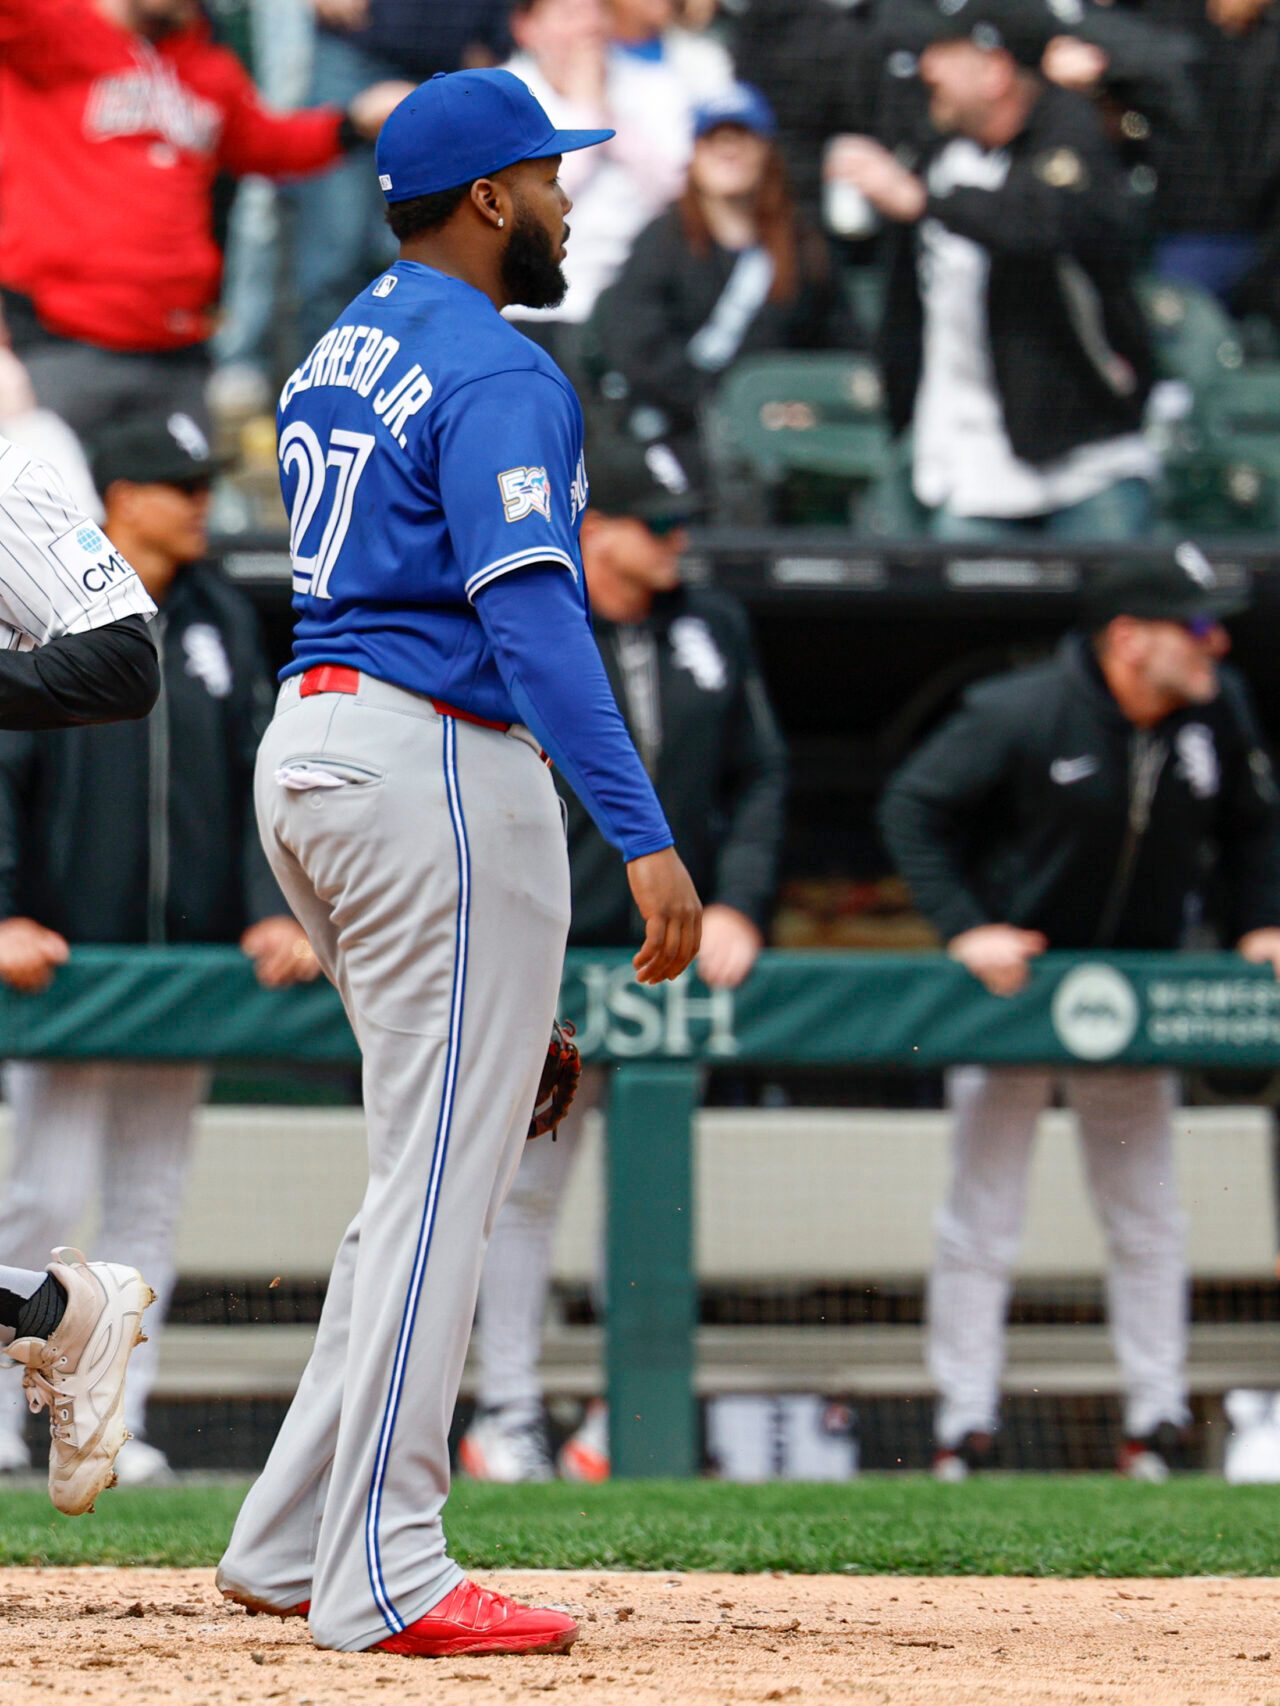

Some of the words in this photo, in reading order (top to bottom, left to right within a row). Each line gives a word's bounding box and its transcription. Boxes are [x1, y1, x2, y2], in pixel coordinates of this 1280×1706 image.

[372, 363, 433, 450] JR.
[278, 420, 376, 600] 27
[558, 963, 739, 1057] USH
